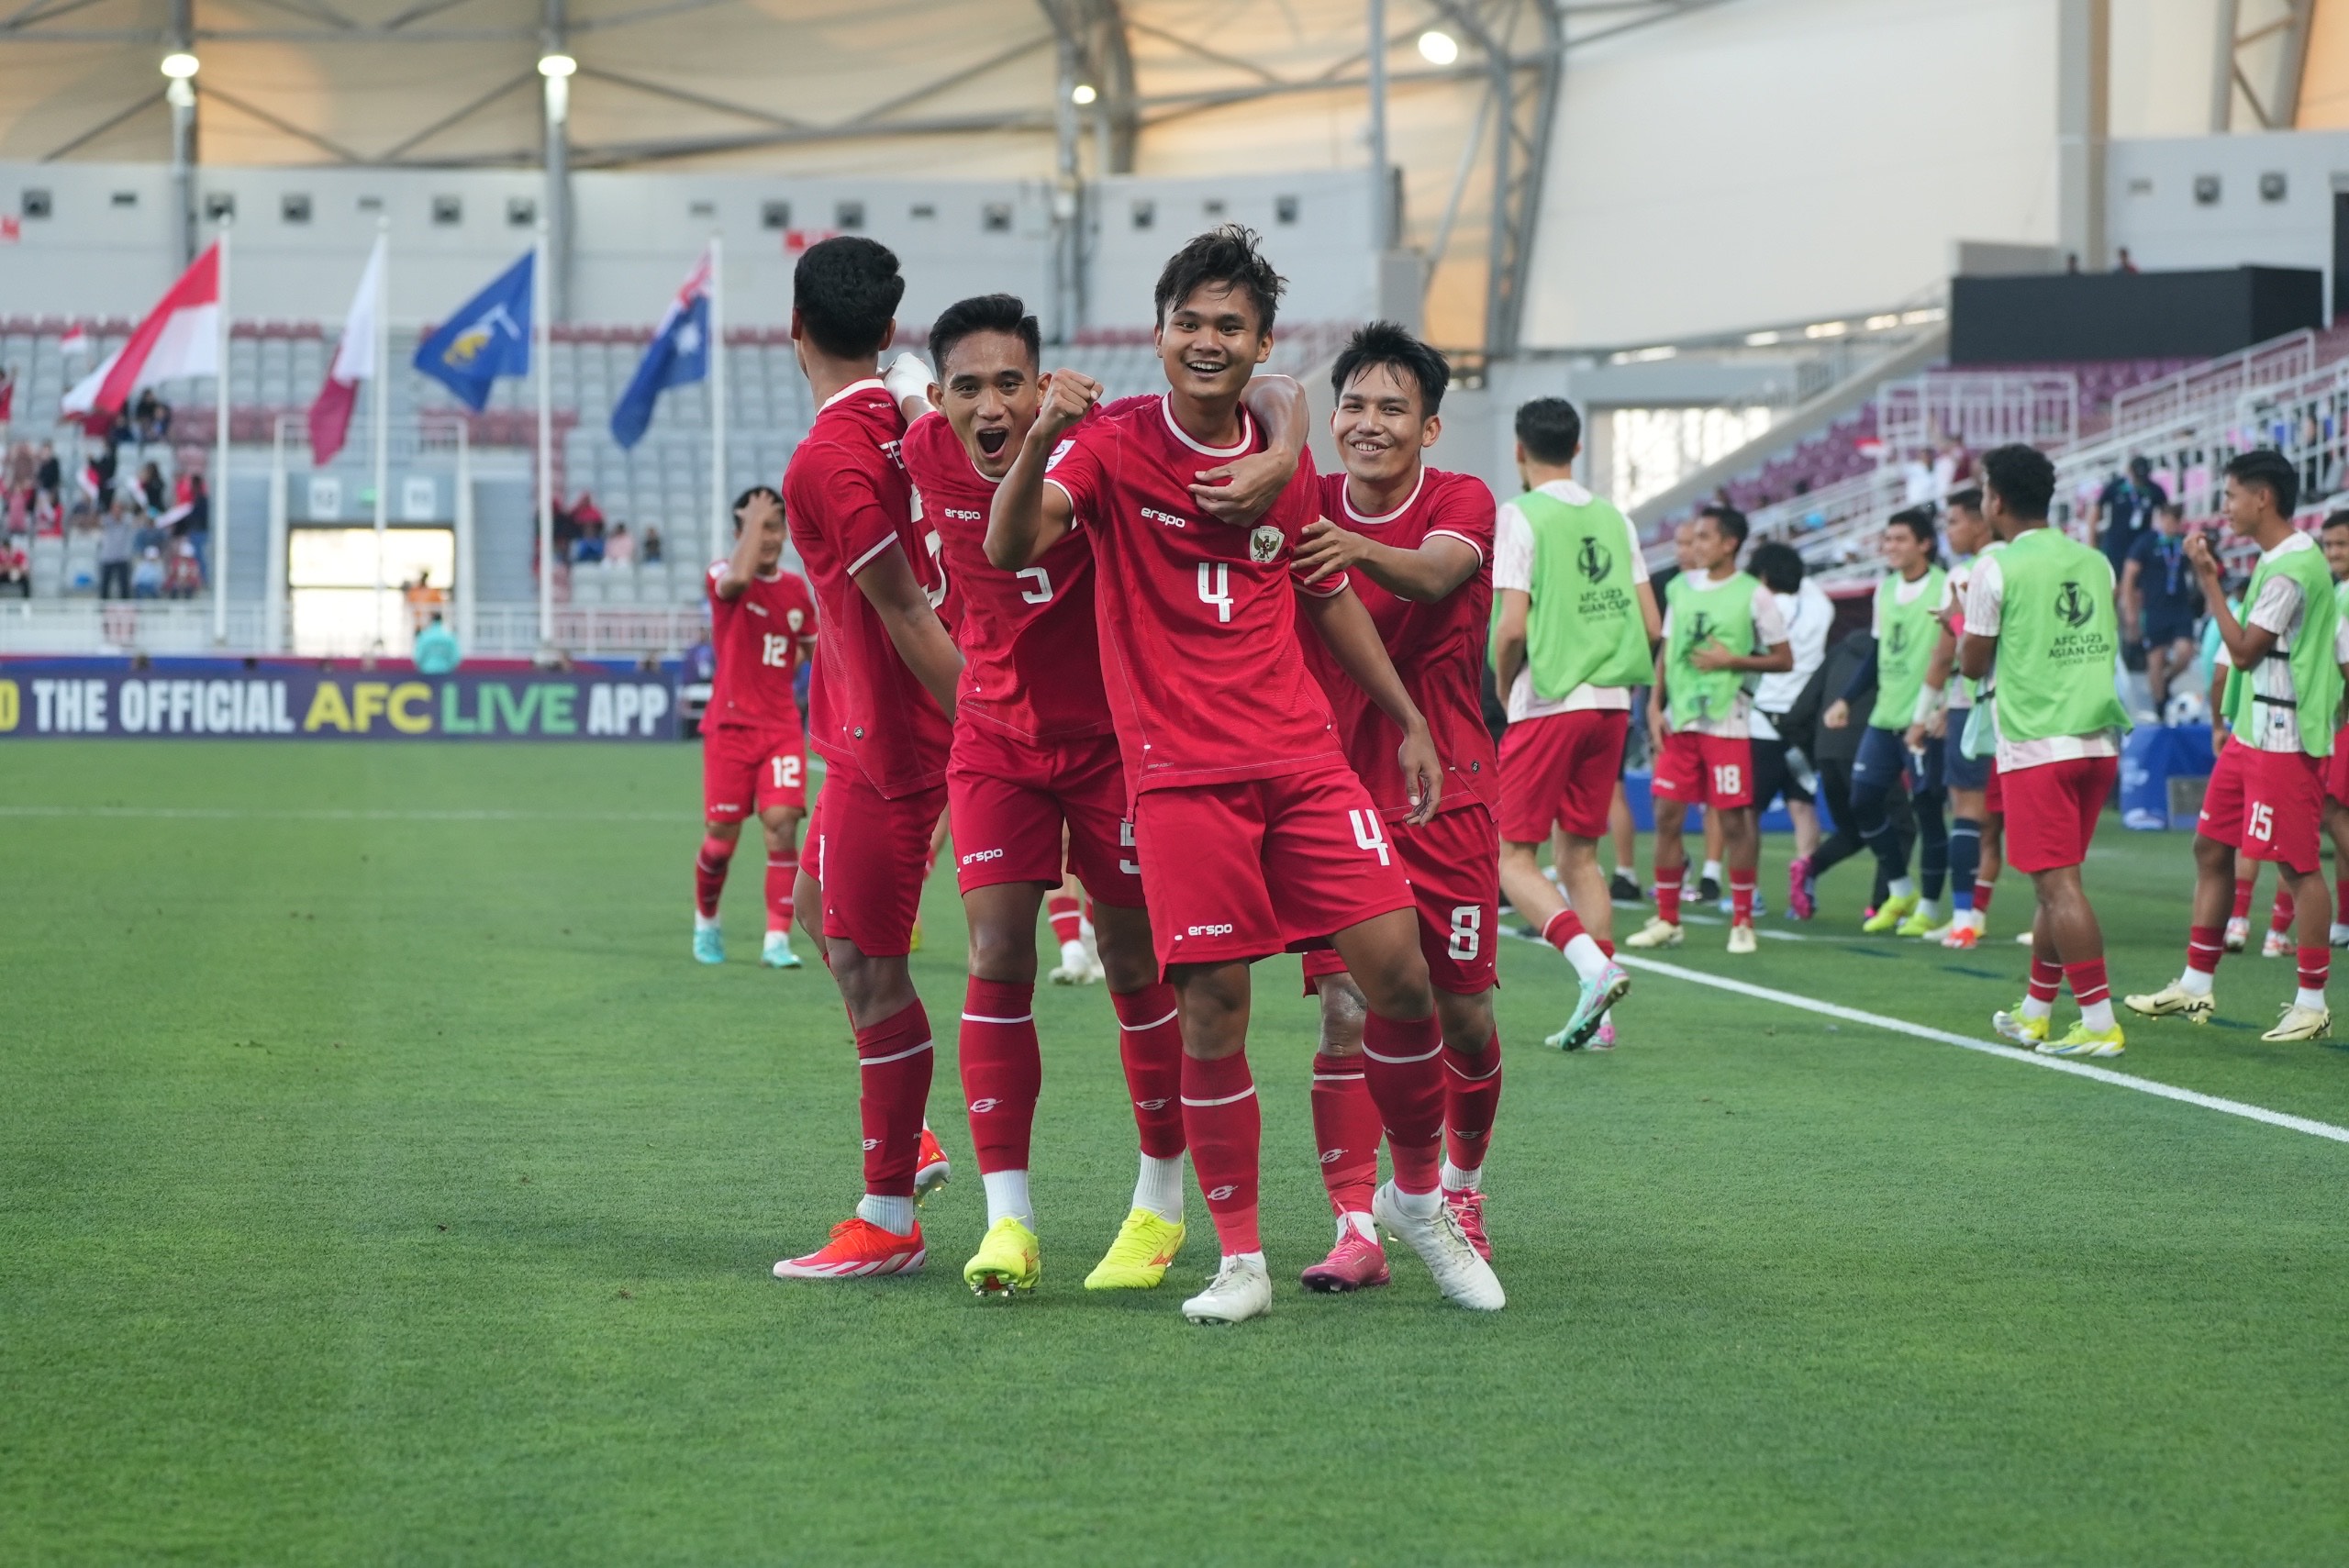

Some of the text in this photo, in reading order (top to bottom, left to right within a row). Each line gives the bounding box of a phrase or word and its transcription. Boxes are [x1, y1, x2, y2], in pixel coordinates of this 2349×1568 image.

[944, 507, 981, 521] erspo
[1141, 507, 1186, 528] erspo
[1197, 562, 1233, 622] 4
[762, 633, 788, 667] 12
[2048, 643, 2110, 659] ASIAN CUP
[32, 679, 107, 732] THE
[119, 679, 295, 733] OFFICIAL
[304, 682, 433, 733] AFC
[441, 683, 579, 733] LIVE
[587, 684, 669, 733] APP
[771, 756, 801, 787] 12
[1714, 764, 1742, 795] 18
[2248, 801, 2274, 841] 15
[1348, 809, 1390, 866] 4
[963, 848, 1004, 865] erspo
[1187, 924, 1233, 937] erspo
[1448, 905, 1481, 961] 8
